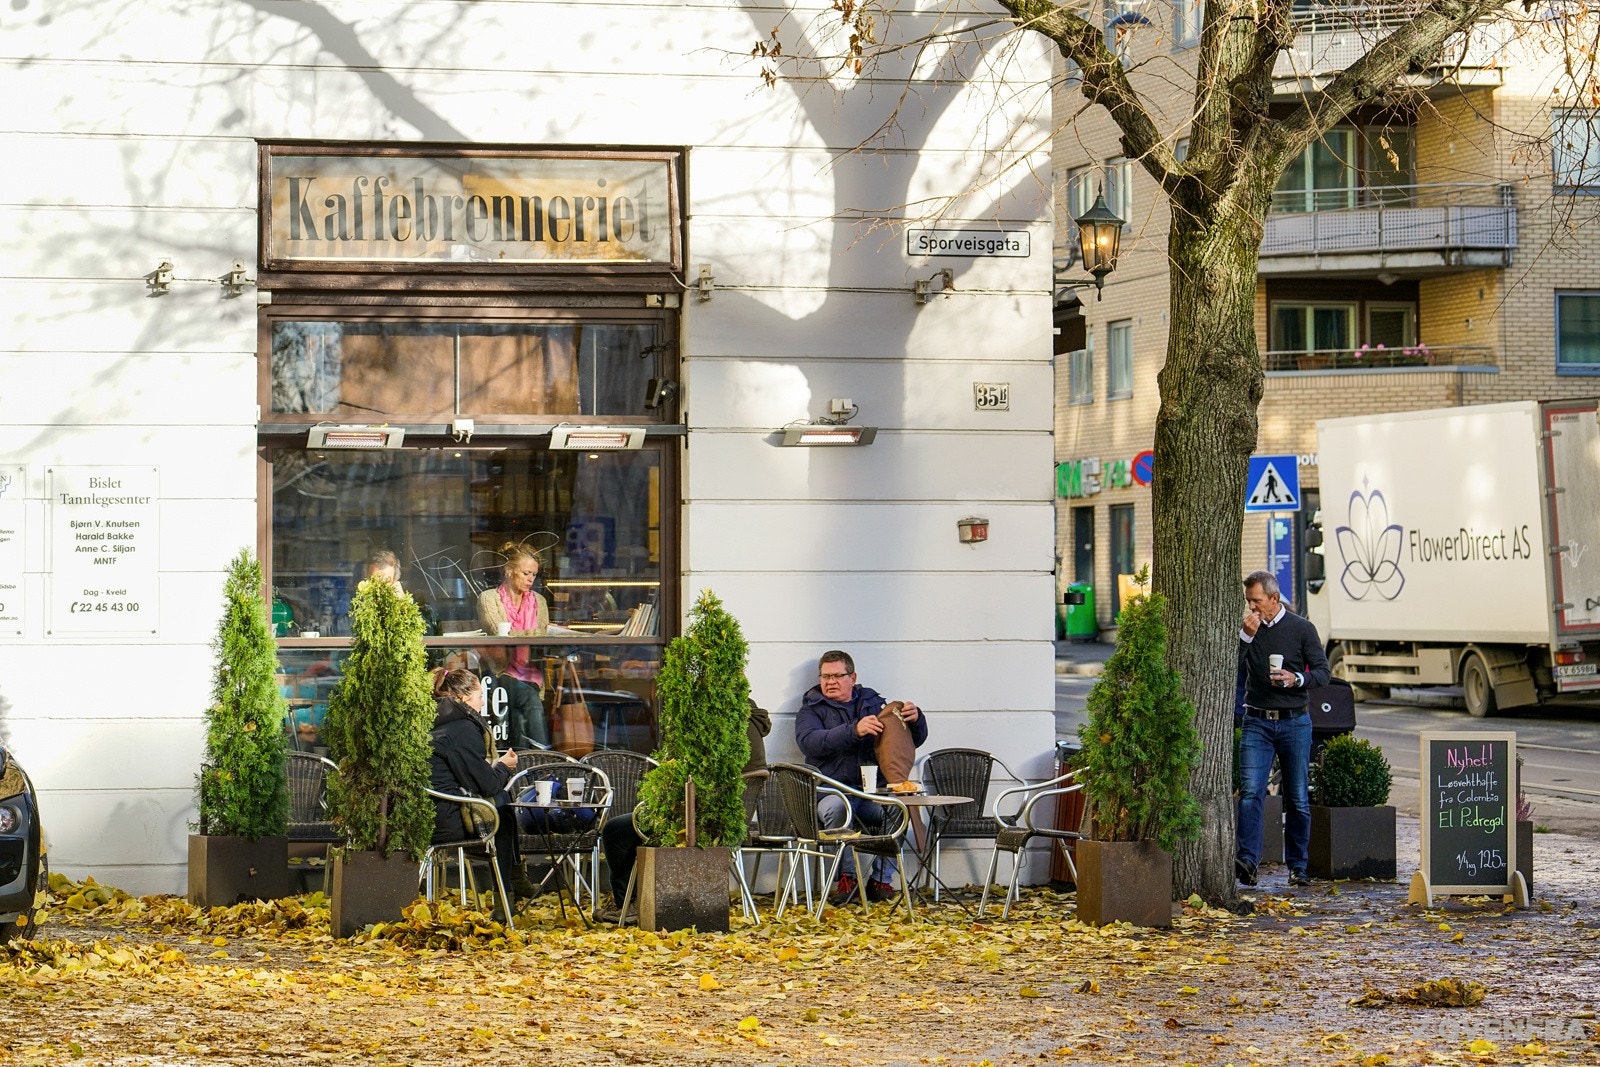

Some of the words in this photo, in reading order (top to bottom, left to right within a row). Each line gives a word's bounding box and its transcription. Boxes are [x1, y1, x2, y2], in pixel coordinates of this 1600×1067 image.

[286, 176, 657, 243] Kaffebrenneriet
[918, 235, 1021, 254] Sporveisgata
[89, 476, 122, 489] Bislet
[60, 492, 151, 508] Tannlegesenter
[70, 520, 93, 530] Bjørn
[95, 520, 104, 528] V.
[106, 520, 140, 528] Knutsen
[75, 532, 105, 540] Harald
[107, 532, 135, 540] Bakke
[101, 544, 111, 552] C.
[113, 545, 136, 554] Siljan
[1409, 527, 1507, 564] FlowerDirect
[1512, 524, 1532, 561] AS
[93, 557, 117, 565] MNTF
[83, 589, 99, 597] Dag
[79, 602, 92, 612] 22
[95, 602, 108, 612] 45
[111, 602, 124, 612] 43
[126, 602, 140, 612] 00
[1447, 743, 1494, 776] Nyhet!
[1439, 791, 1454, 809] fra
[1457, 789, 1499, 804] Colombia
[1439, 809, 1454, 829] El
[1461, 805, 1505, 834] Pedregal
